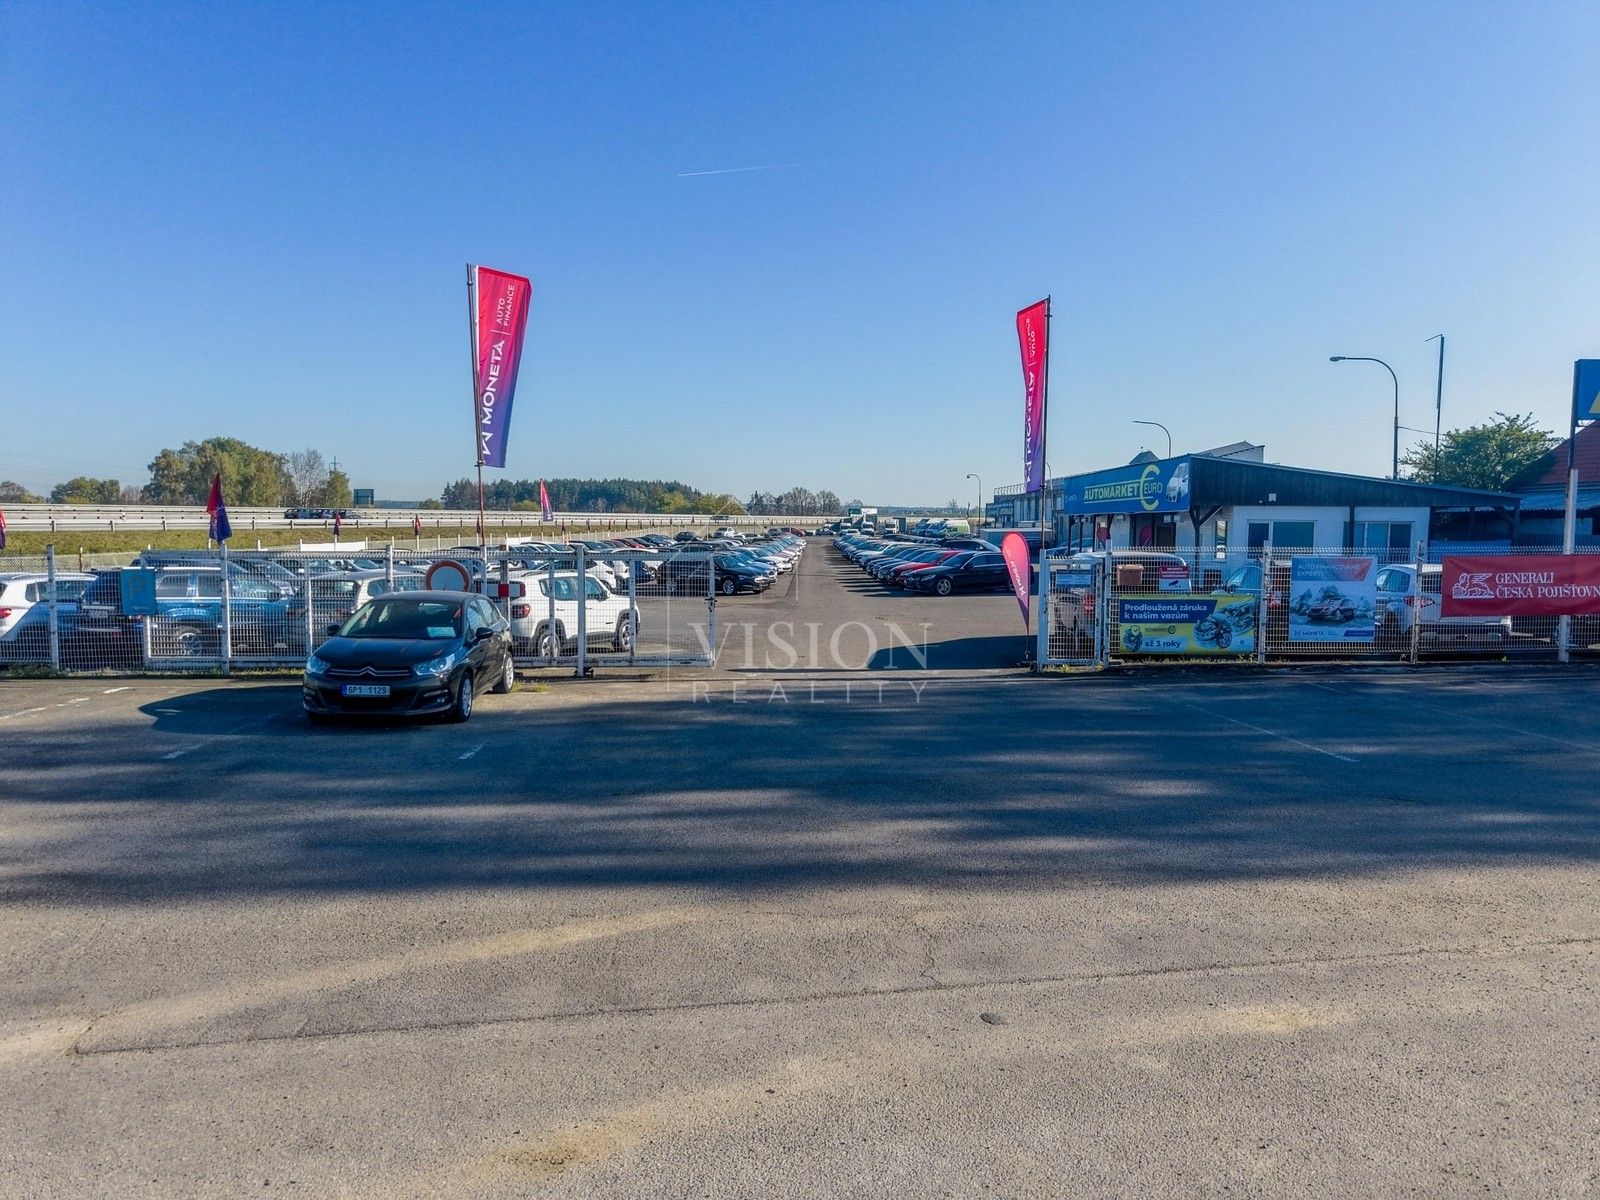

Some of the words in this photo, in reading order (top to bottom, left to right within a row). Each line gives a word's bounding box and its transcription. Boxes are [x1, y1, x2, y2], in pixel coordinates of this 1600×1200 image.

[496, 297, 506, 325] AUTO
[503, 284, 515, 327] FINANCE
[482, 340, 505, 425] MONETA
[1083, 482, 1140, 501] AUTOMARKET
[1143, 482, 1163, 495] EURO
[1495, 572, 1555, 584] GENERALI
[1496, 584, 1534, 599] ČESKÁ
[1124, 603, 1178, 611] Prodloužená
[1179, 603, 1207, 611] záruka
[1132, 611, 1159, 619] našim
[1160, 611, 1189, 619] vozům
[1144, 639, 1153, 647] až
[1163, 640, 1181, 649] roky
[368, 687, 387, 695] 1129
